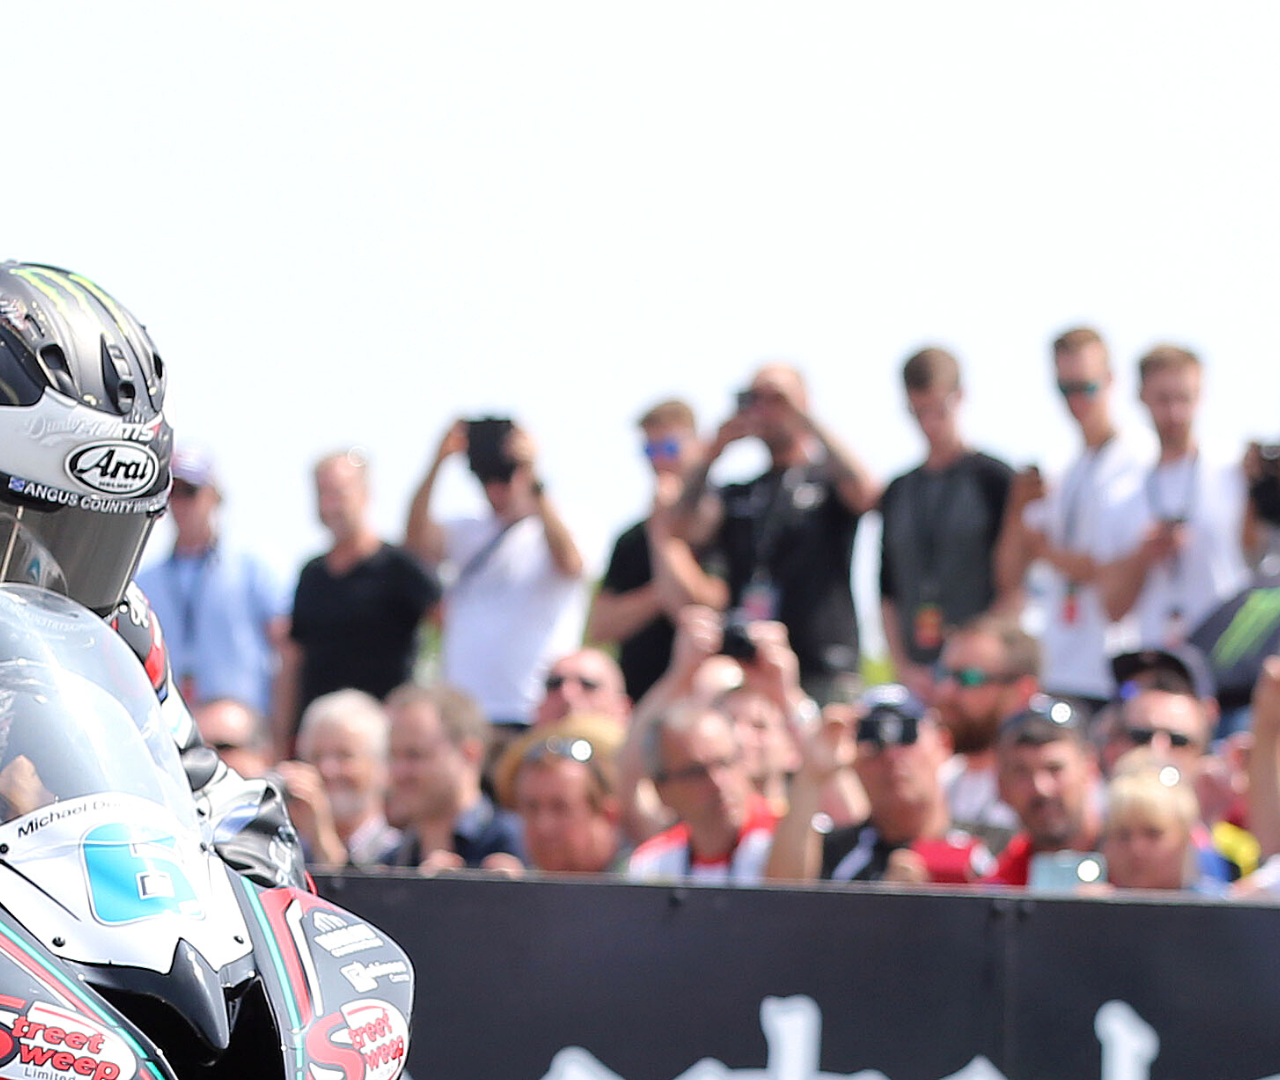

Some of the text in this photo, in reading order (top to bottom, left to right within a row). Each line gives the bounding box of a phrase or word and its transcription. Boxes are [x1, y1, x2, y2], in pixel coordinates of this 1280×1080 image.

[74, 449, 150, 480] Arai
[23, 482, 78, 507] ANGUS
[80, 495, 134, 513] COUNTY
[17, 802, 88, 839] Michael
